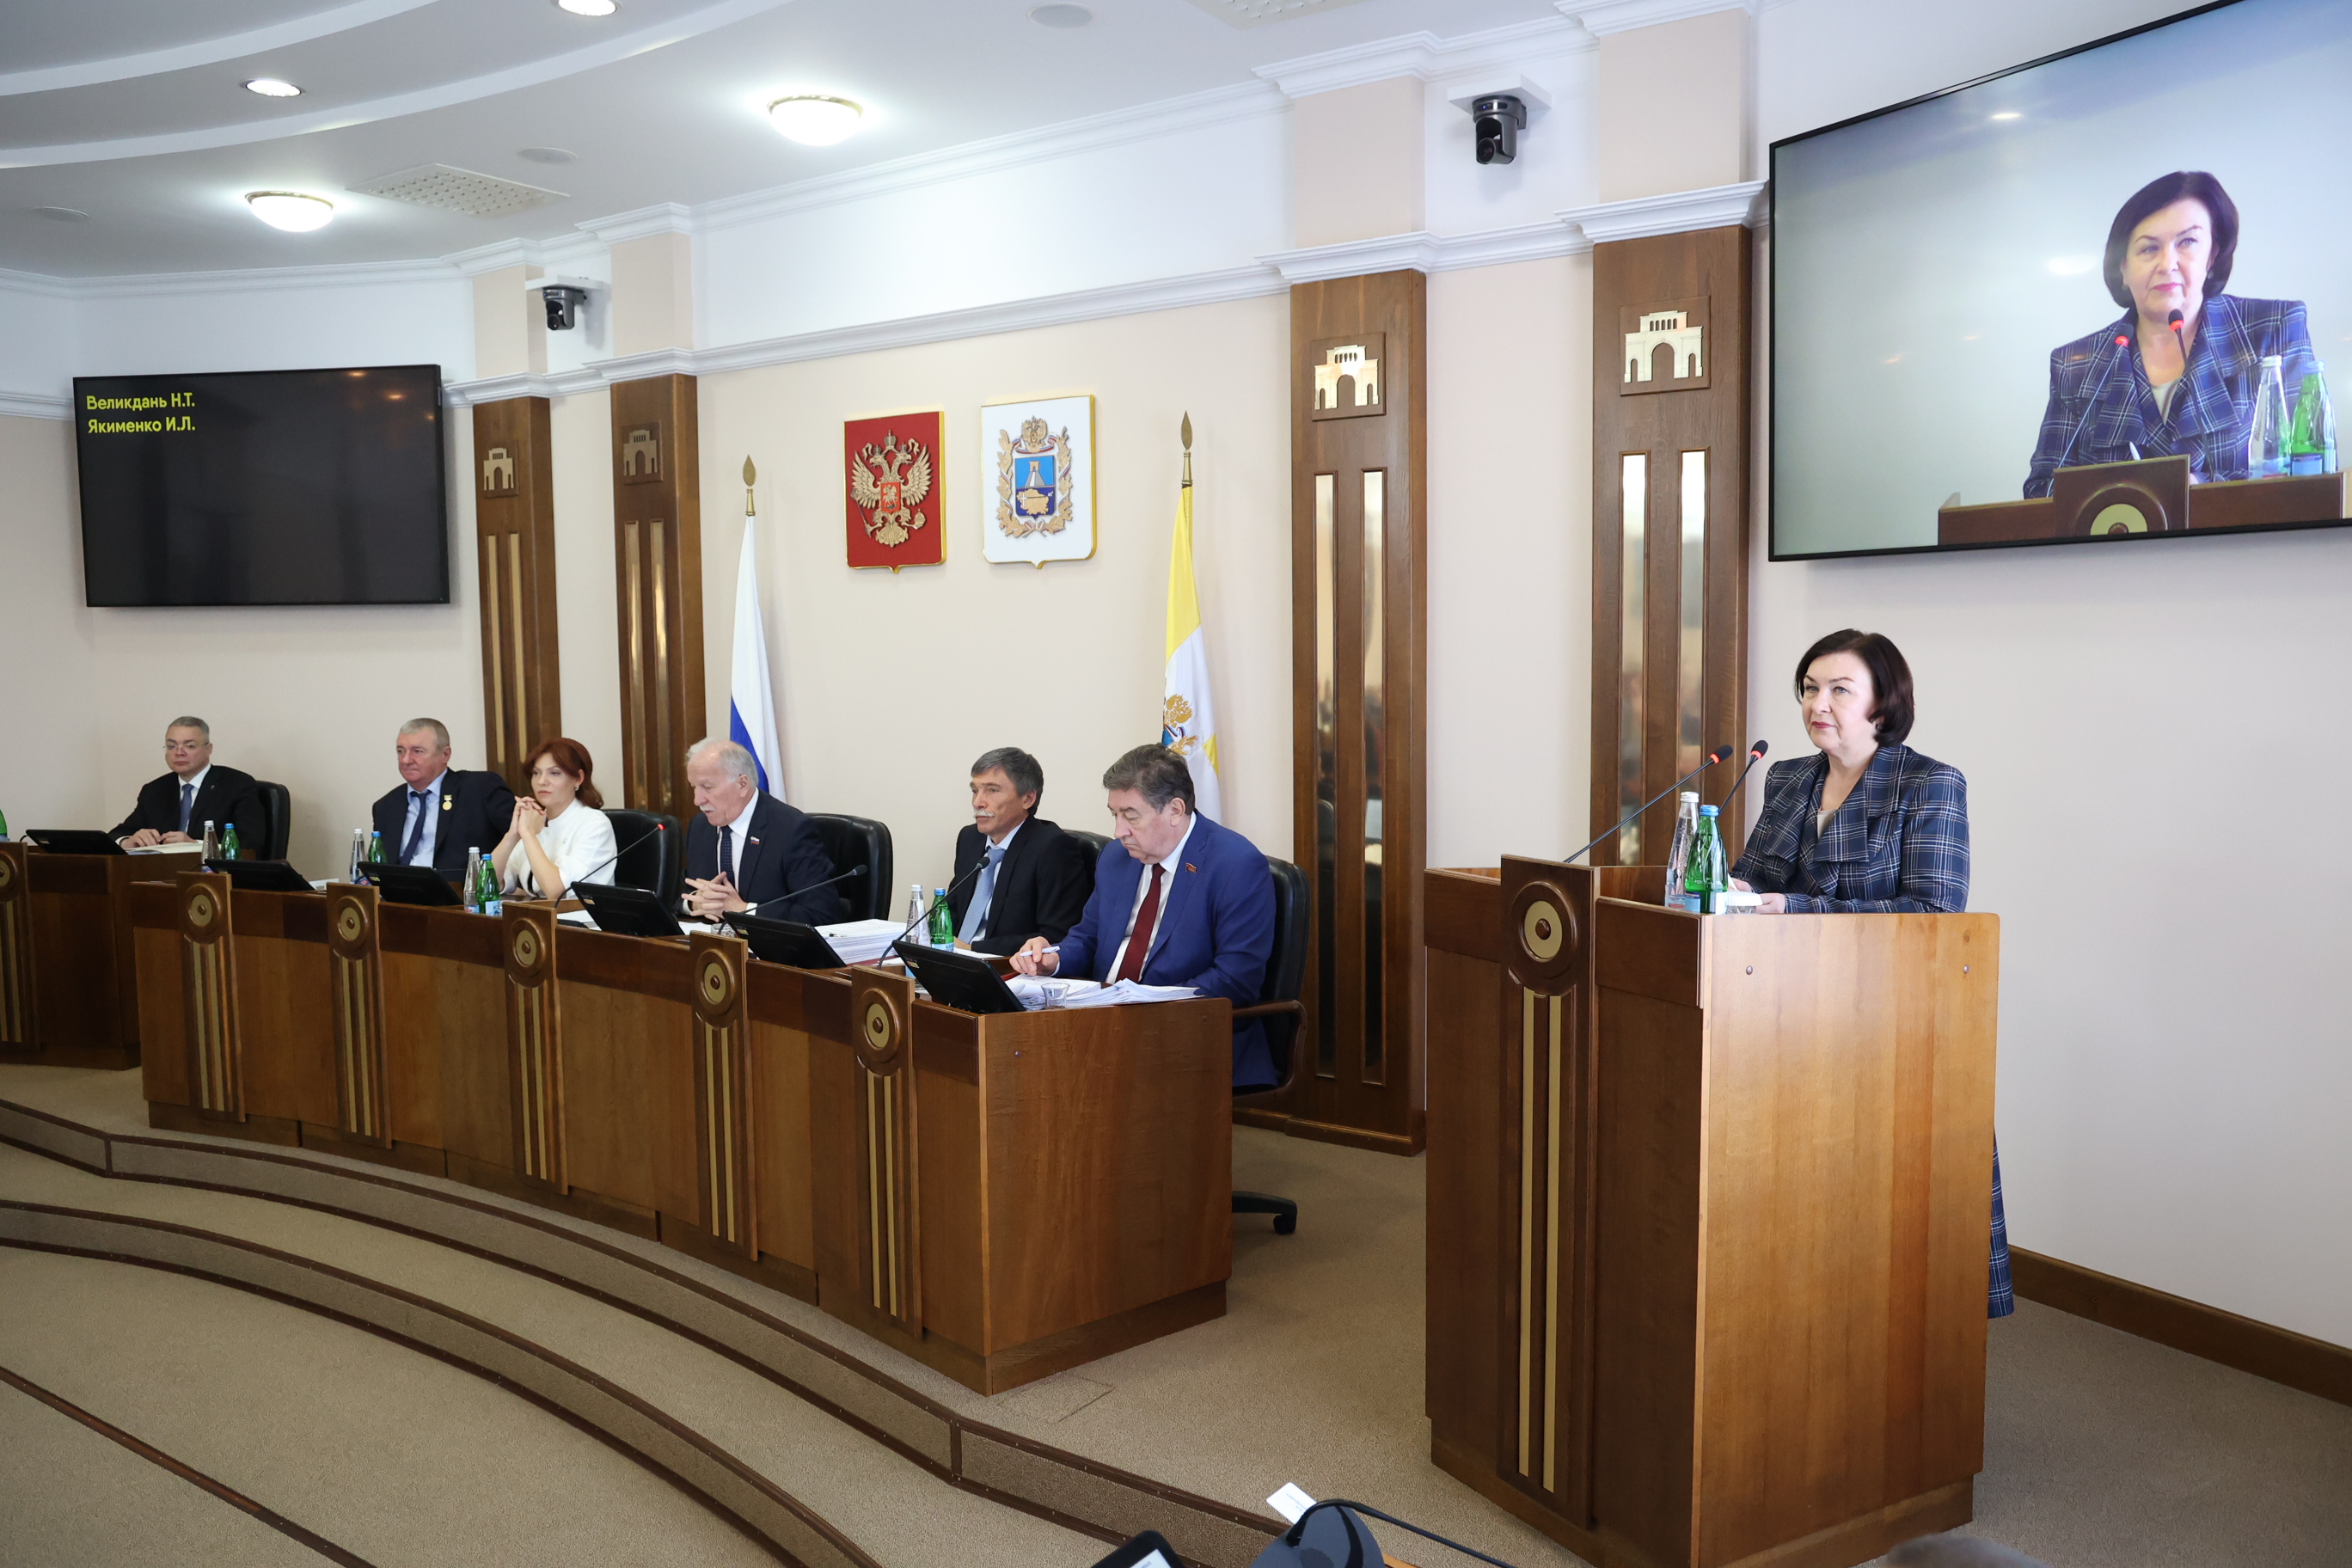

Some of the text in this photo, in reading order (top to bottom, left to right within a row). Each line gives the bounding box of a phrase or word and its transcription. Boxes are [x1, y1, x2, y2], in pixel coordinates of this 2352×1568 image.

[86, 392, 195, 411] Великдань Н.Т.
[88, 416, 195, 433] Якименко И.Л.
